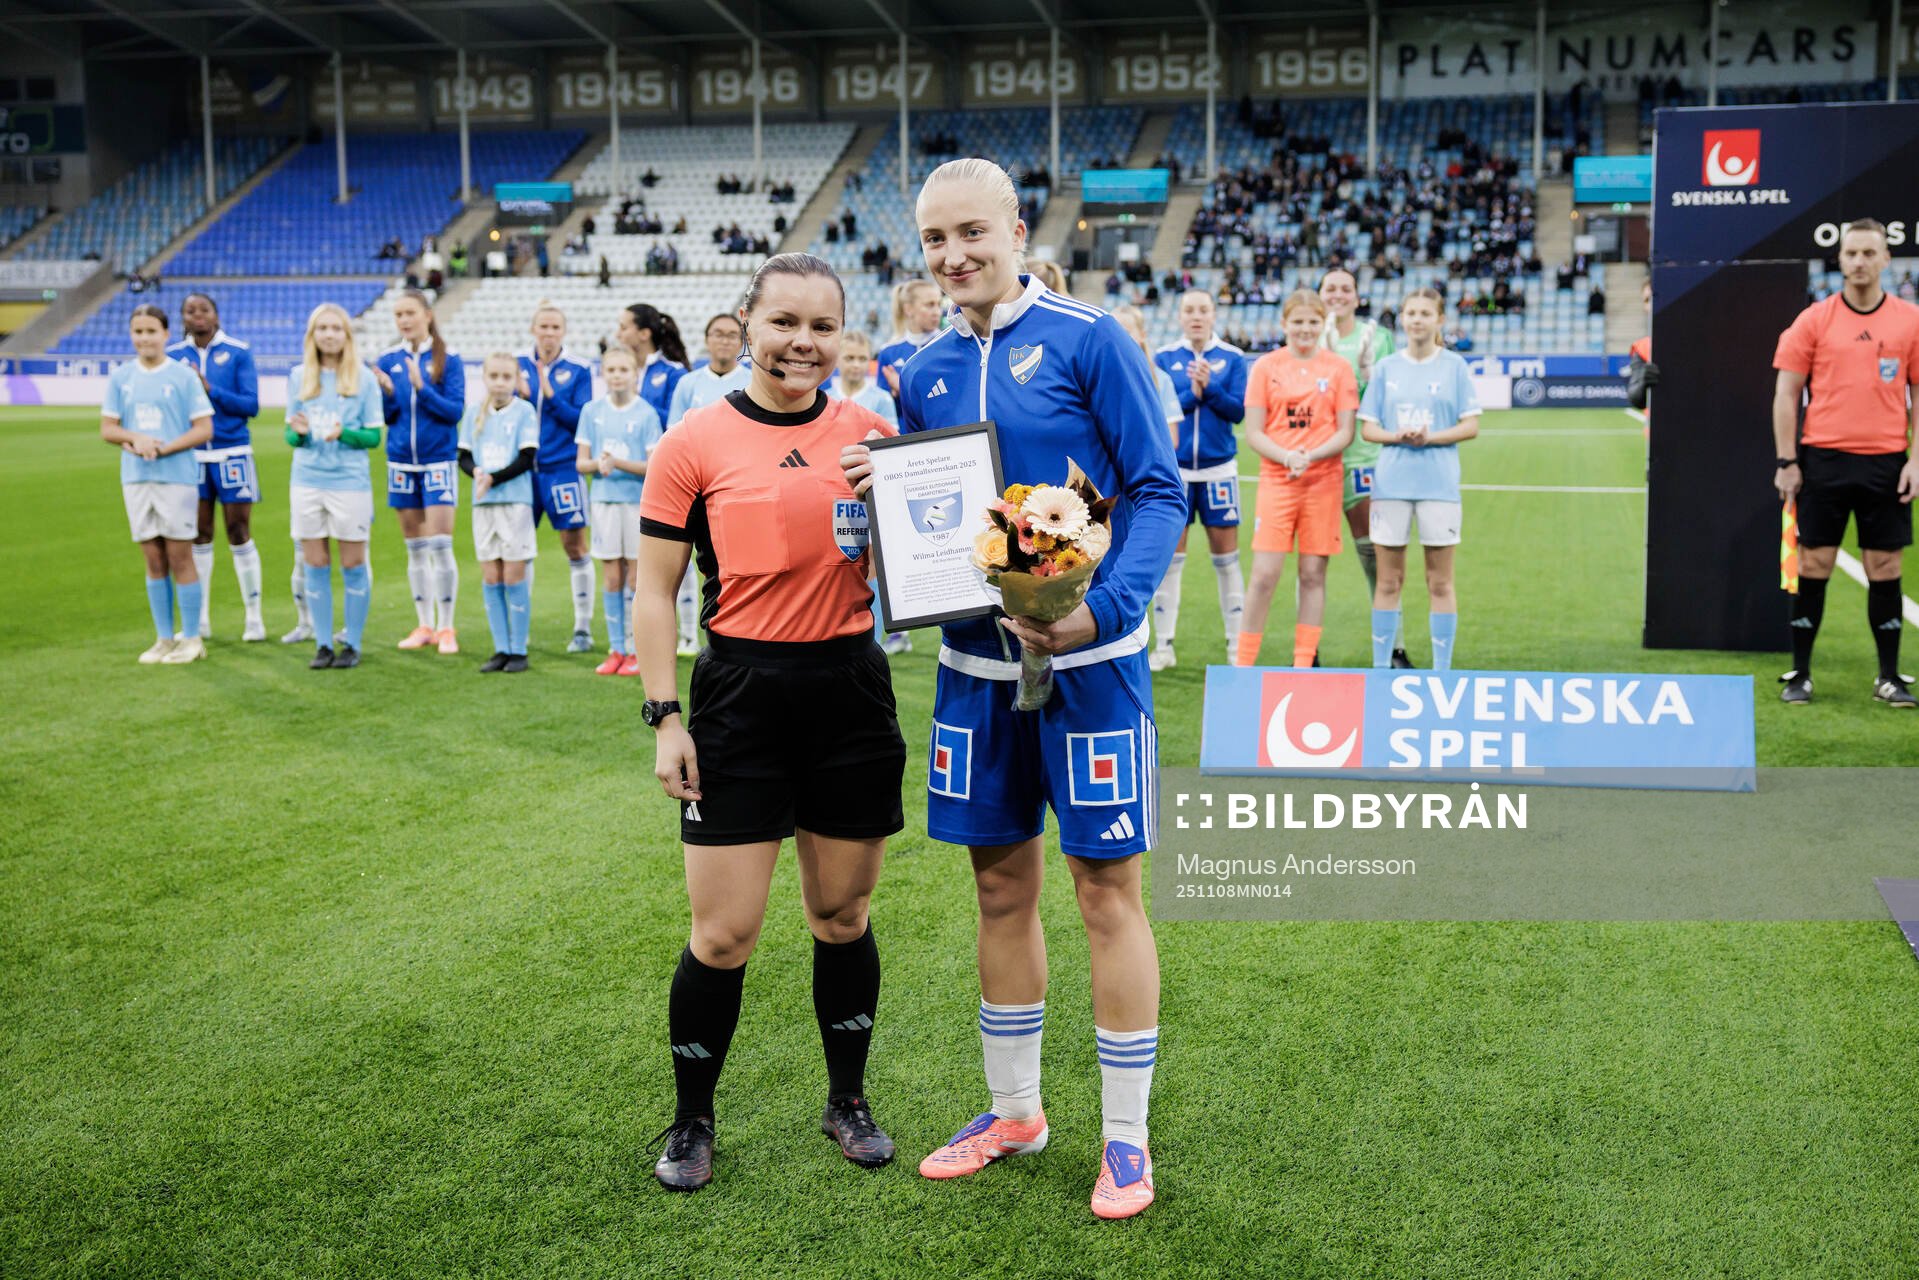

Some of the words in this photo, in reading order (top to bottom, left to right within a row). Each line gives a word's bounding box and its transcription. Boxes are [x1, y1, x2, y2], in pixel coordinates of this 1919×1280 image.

[1257, 48, 1368, 86] 1956
[1397, 25, 1858, 78] PLATNUMCARS
[557, 71, 665, 108] 1945
[697, 67, 799, 104] 1946
[832, 63, 933, 100] 1947
[1111, 53, 1222, 93] 1952
[434, 75, 533, 112] 1943
[1671, 190, 1746, 207] SVENSKA
[1749, 189, 1790, 205] SPEL
[1813, 221, 1906, 247] OS
[884, 473, 904, 481] OBOS
[904, 465, 958, 478] Damallsvenskan
[959, 460, 977, 469] 2025
[907, 460, 925, 468] Årets
[926, 456, 951, 465] Spelare
[836, 503, 866, 518] FIFA
[836, 527, 868, 536] REFEREE
[932, 533, 950, 541] 1987
[912, 552, 935, 561] Wilma
[936, 546, 973, 557] Leidhamm
[1390, 675, 1694, 725] SVENSKA
[1389, 728, 1545, 775] SPEL
